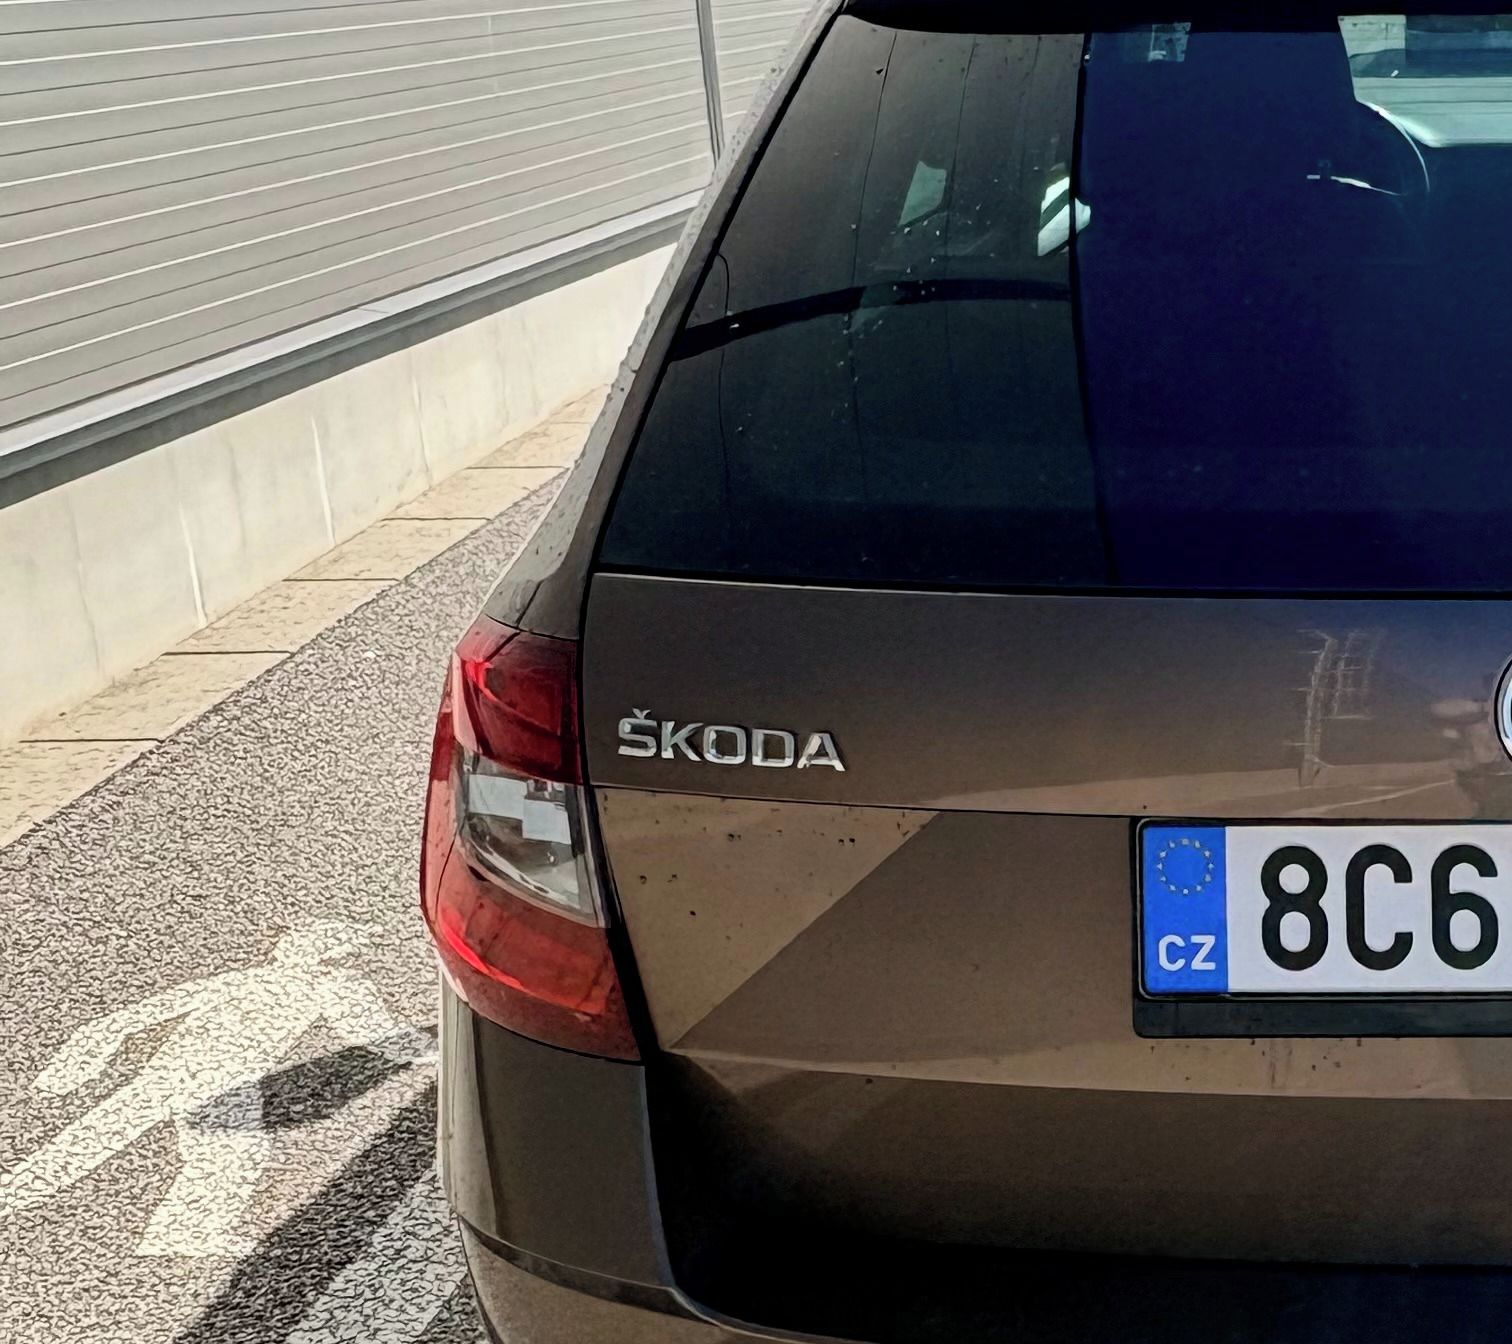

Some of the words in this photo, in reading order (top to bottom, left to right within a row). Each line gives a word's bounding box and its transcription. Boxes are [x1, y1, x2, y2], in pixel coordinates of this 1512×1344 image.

[618, 707, 846, 772] ŠKODA
[1260, 843, 1500, 972] 8C6
[1157, 935, 1217, 972] CZ
